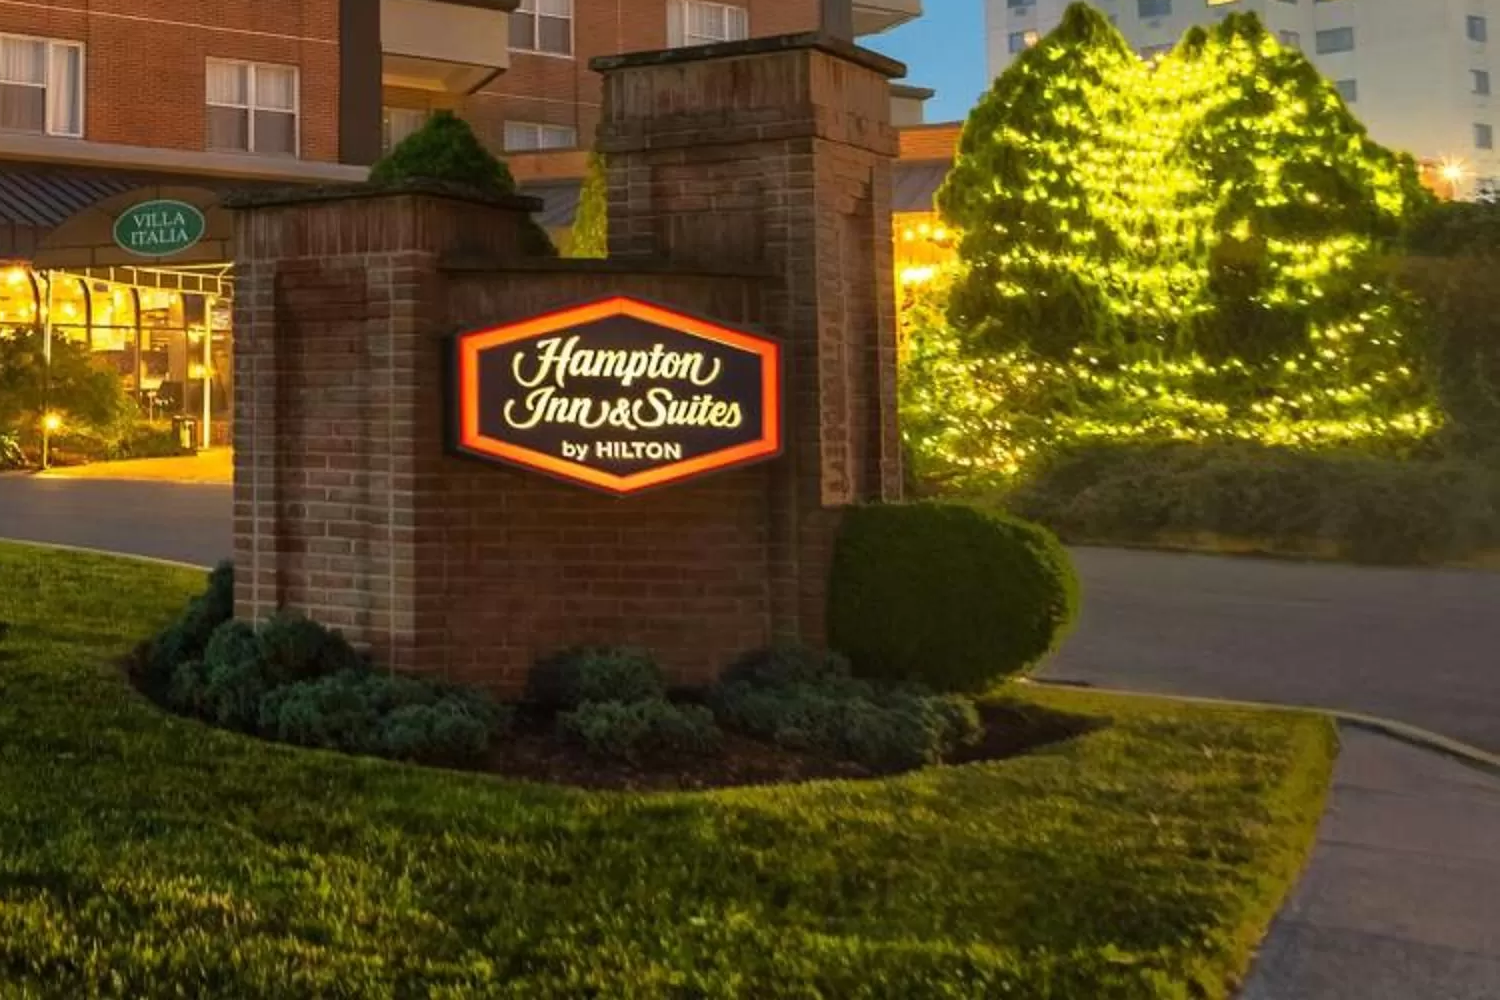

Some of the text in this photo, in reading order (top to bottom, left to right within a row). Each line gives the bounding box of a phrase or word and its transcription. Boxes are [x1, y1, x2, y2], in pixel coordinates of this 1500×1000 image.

[133, 212, 186, 228] VILLA
[131, 228, 189, 245] ITALIA
[513, 336, 721, 388] Hampton
[504, 386, 611, 429] Inn
[632, 387, 743, 429] Suites
[562, 440, 682, 461] by HILTON
